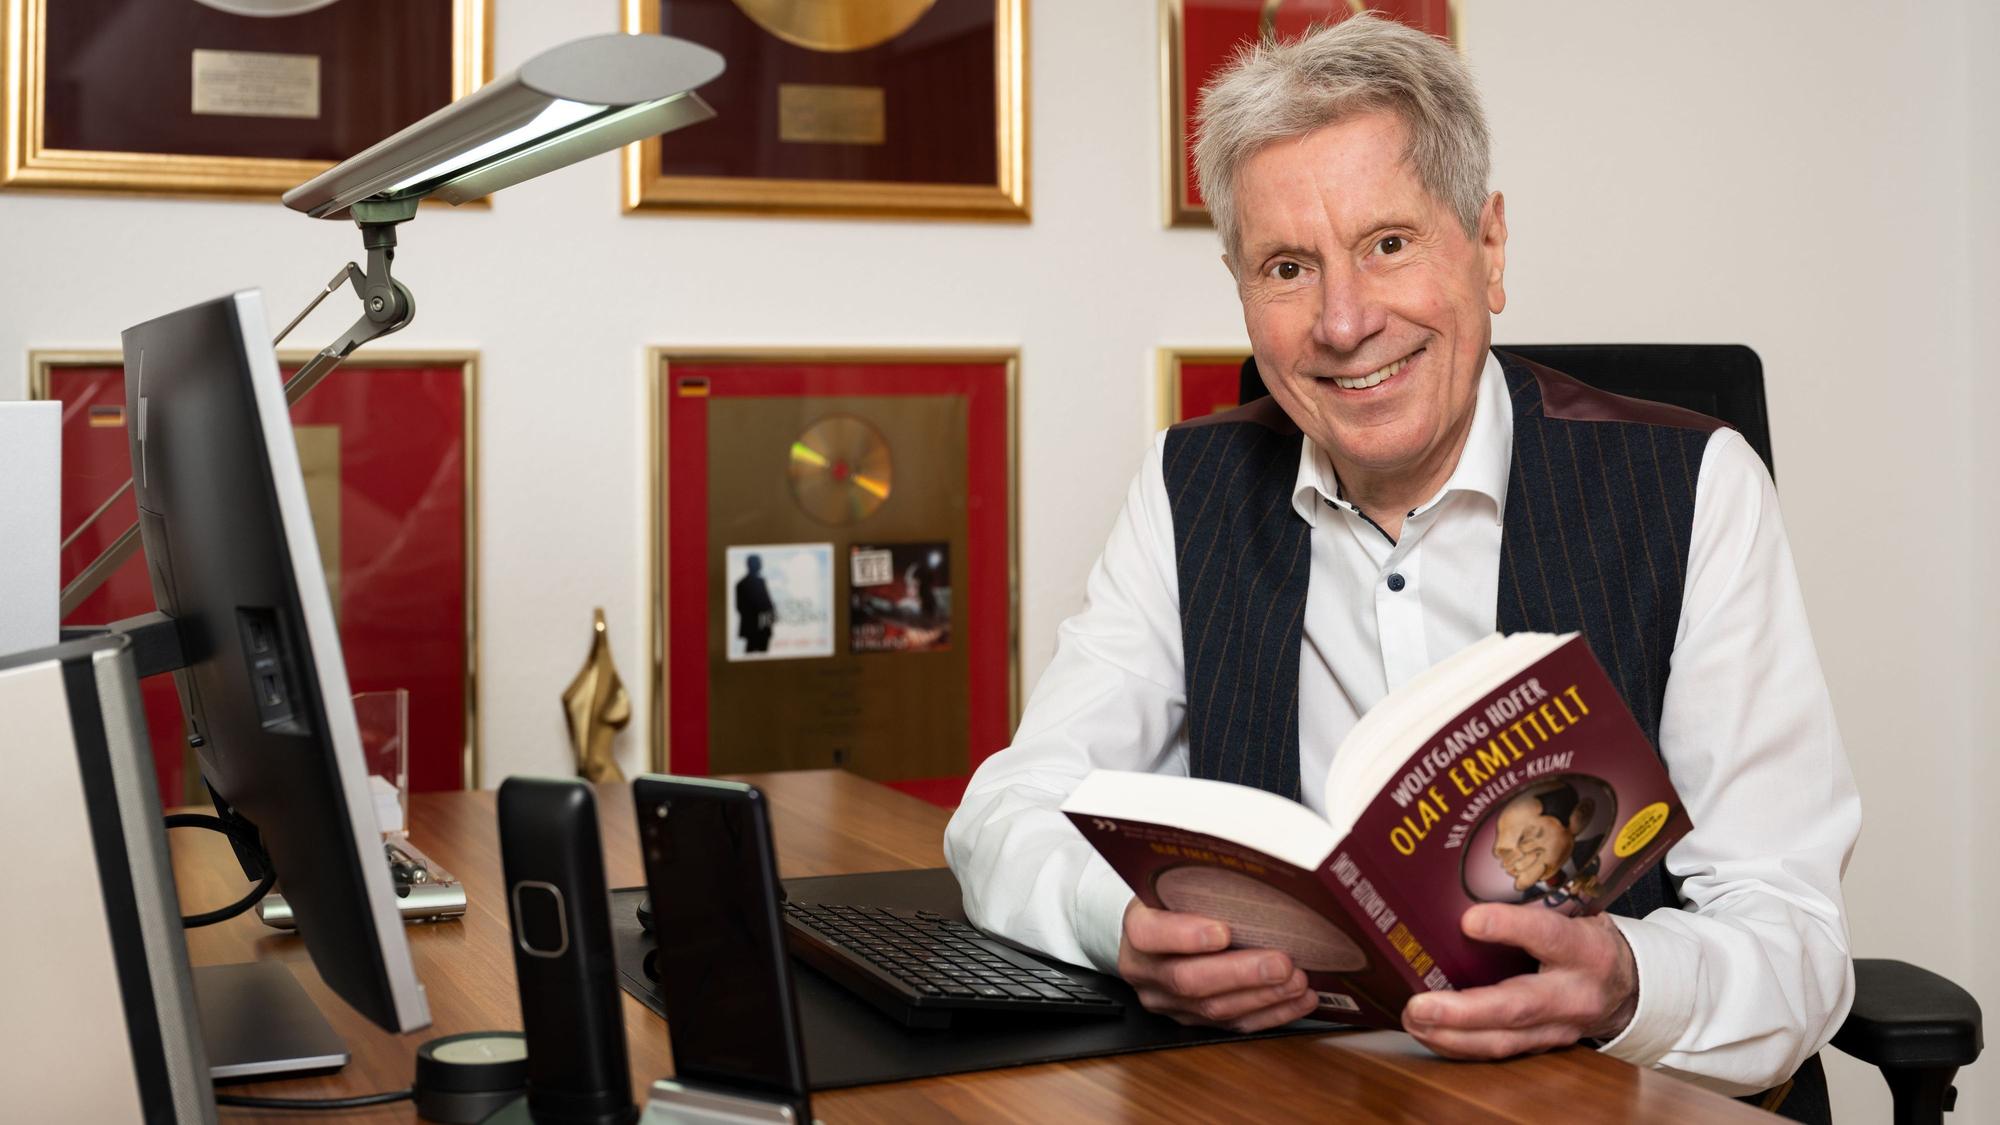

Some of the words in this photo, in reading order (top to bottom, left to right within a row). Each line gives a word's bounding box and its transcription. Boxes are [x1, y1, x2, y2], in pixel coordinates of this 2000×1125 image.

[1390, 716, 1490, 808] WOLFGANG
[1484, 677, 1549, 728] HOFER
[1390, 785, 1450, 856] OLAF
[1448, 684, 1591, 797] ERMITTELT
[1444, 823, 1471, 849] DER
[1460, 750, 1575, 823] KANZLER-KRIMI
